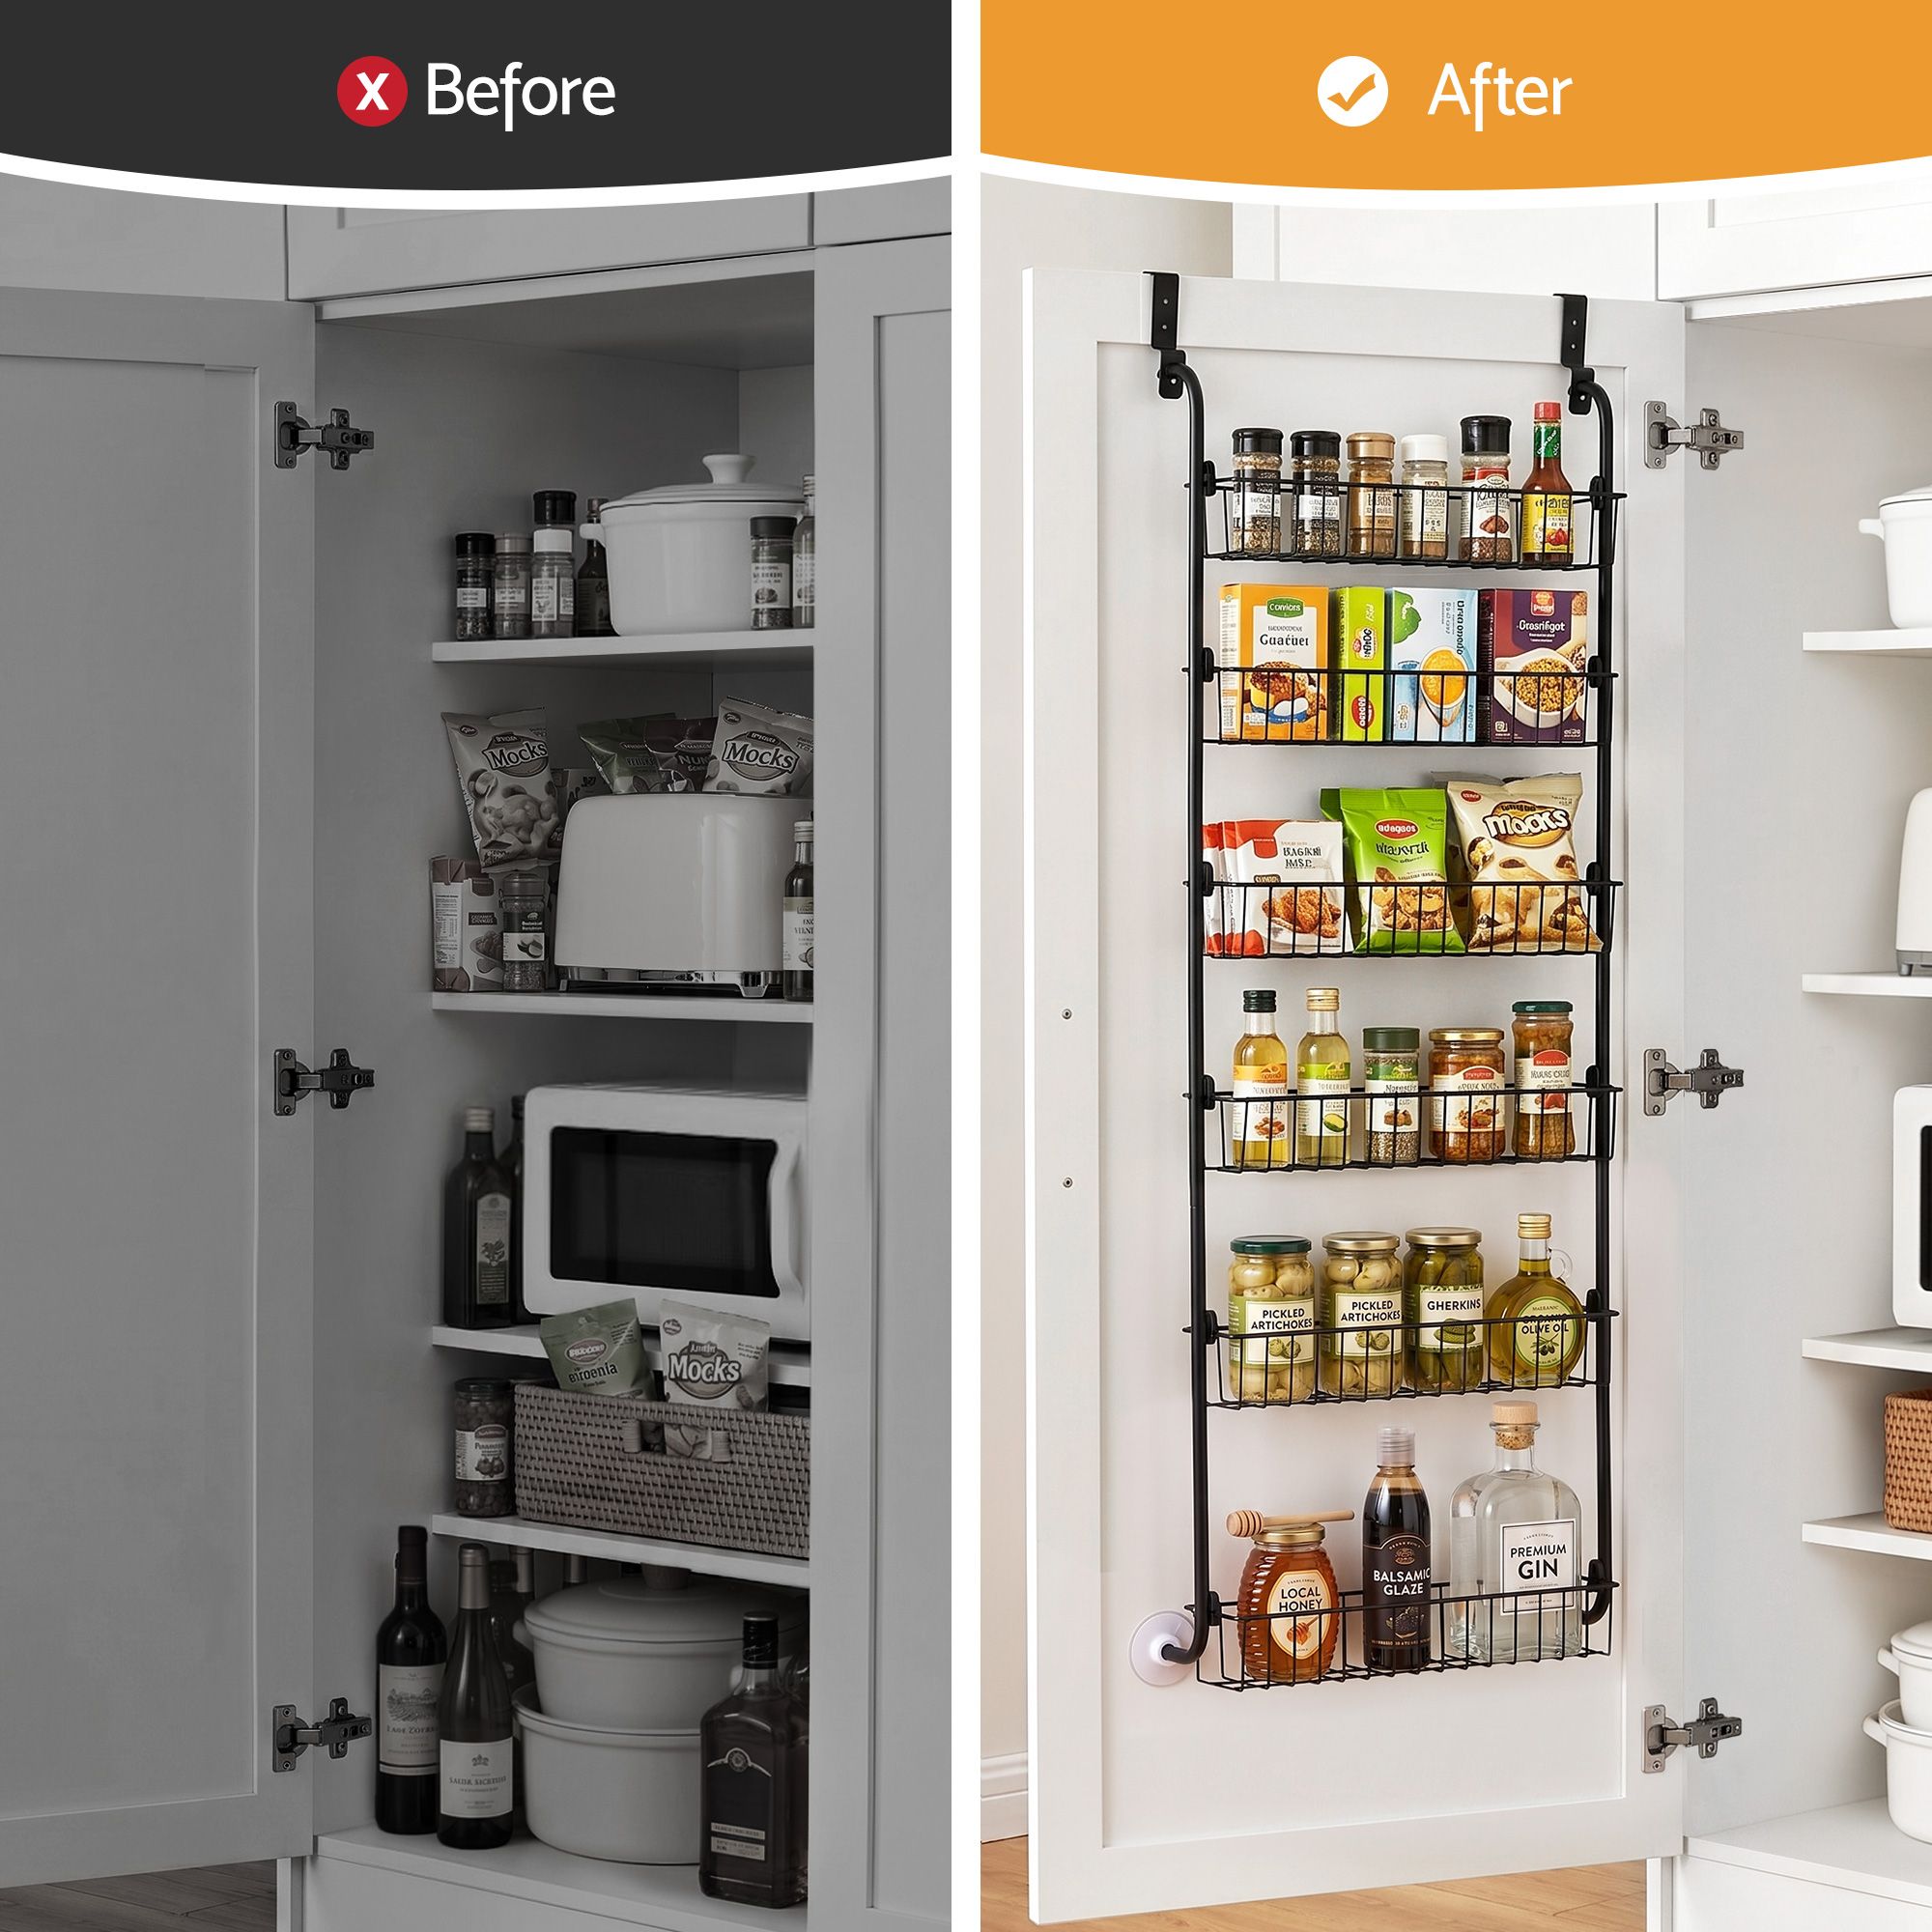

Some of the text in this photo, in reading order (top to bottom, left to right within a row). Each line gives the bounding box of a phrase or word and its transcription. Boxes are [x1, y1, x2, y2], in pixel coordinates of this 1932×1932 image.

[487, 741, 549, 768] Mocks
[724, 742, 794, 769] Mocks
[1352, 1299, 1393, 1311] PICKLED
[1427, 1297, 1481, 1312] GHERKINS
[1263, 1307, 1305, 1320] PICKLED
[1340, 1309, 1401, 1322] ARTICHOKES
[1251, 1317, 1313, 1330] ARTICHOKES
[668, 1353, 742, 1383] Mocks
[1510, 1544, 1567, 1558] PREMIUM
[1373, 1567, 1431, 1583] BALSAMIC
[1518, 1557, 1558, 1580] GIN
[1281, 1585, 1321, 1600] LOCAL
[1383, 1582, 1424, 1596] GLAZE
[1278, 1598, 1323, 1612] HONEY
